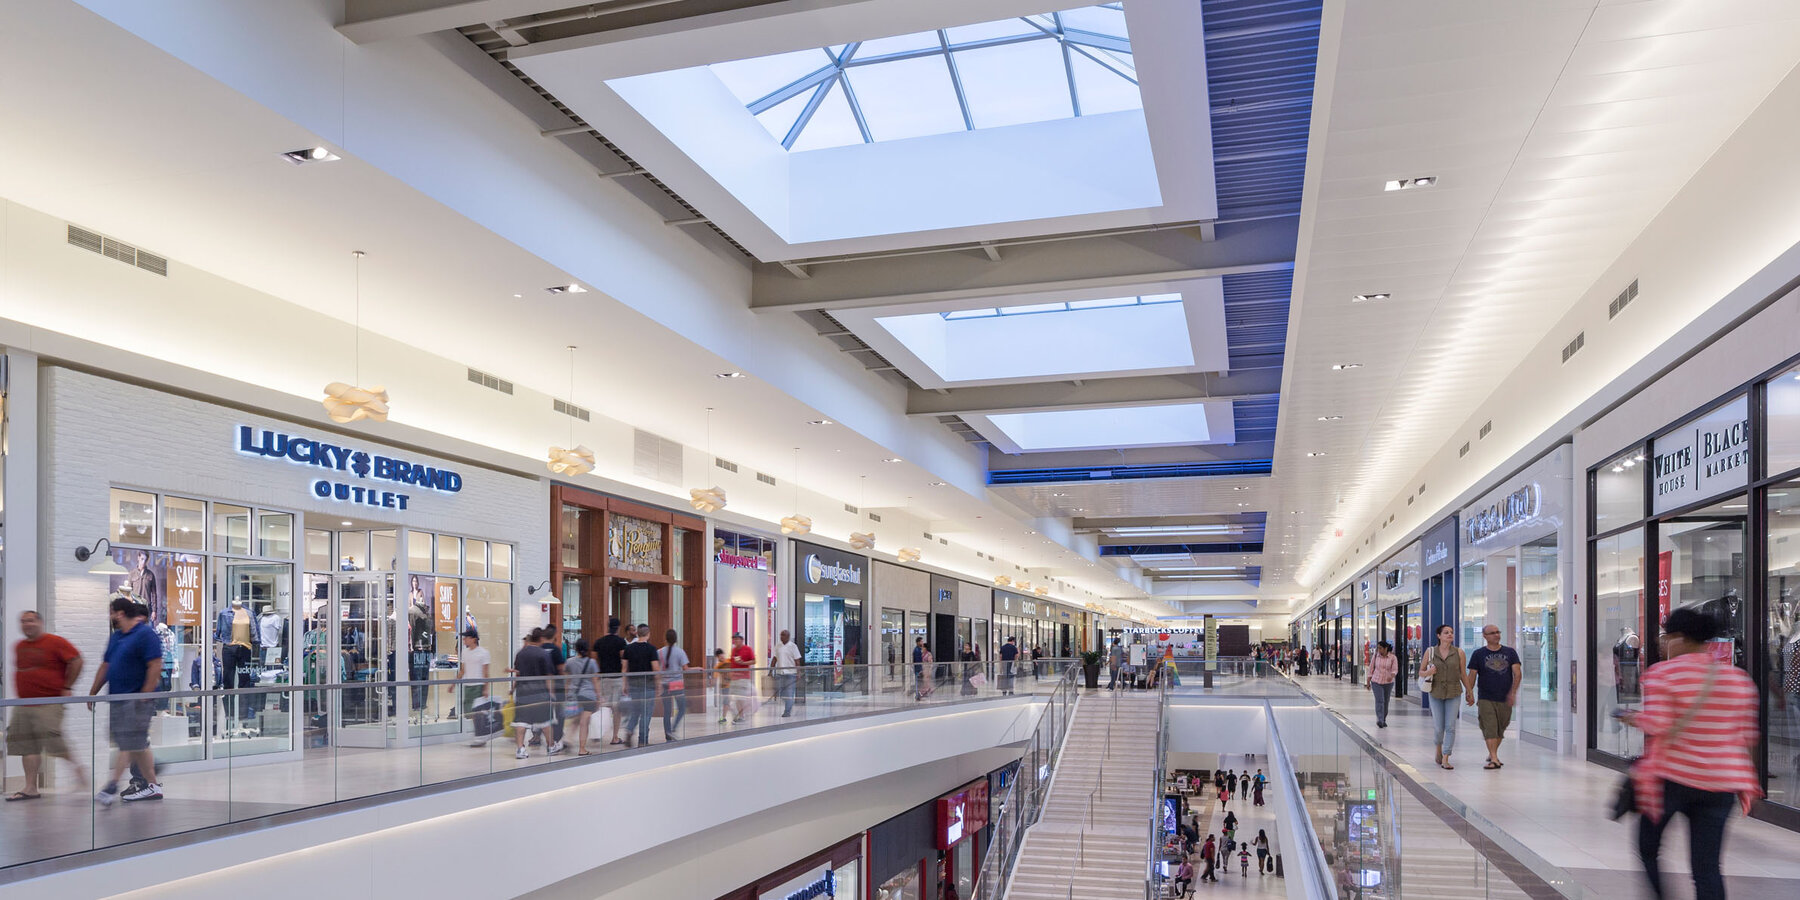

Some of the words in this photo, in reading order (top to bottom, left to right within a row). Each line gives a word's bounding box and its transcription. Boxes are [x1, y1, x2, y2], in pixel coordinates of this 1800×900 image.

[240, 426, 353, 471] LUCKY
[374, 456, 462, 493] BRAND
[1654, 446, 1692, 479] WHITE
[1706, 449, 1748, 478] MARKET
[315, 480, 409, 510] OUTLET
[1659, 474, 1686, 496] HOUSE
[176, 565, 199, 588] SAVE
[821, 561, 849, 585] sunglass
[849, 564, 861, 584] hut
[178, 588, 194, 611] $40
[439, 585, 453, 603] SAVE
[441, 603, 451, 620] $40
[1022, 600, 1036, 615] GUCCI
[236, 665, 254, 676] lucky
